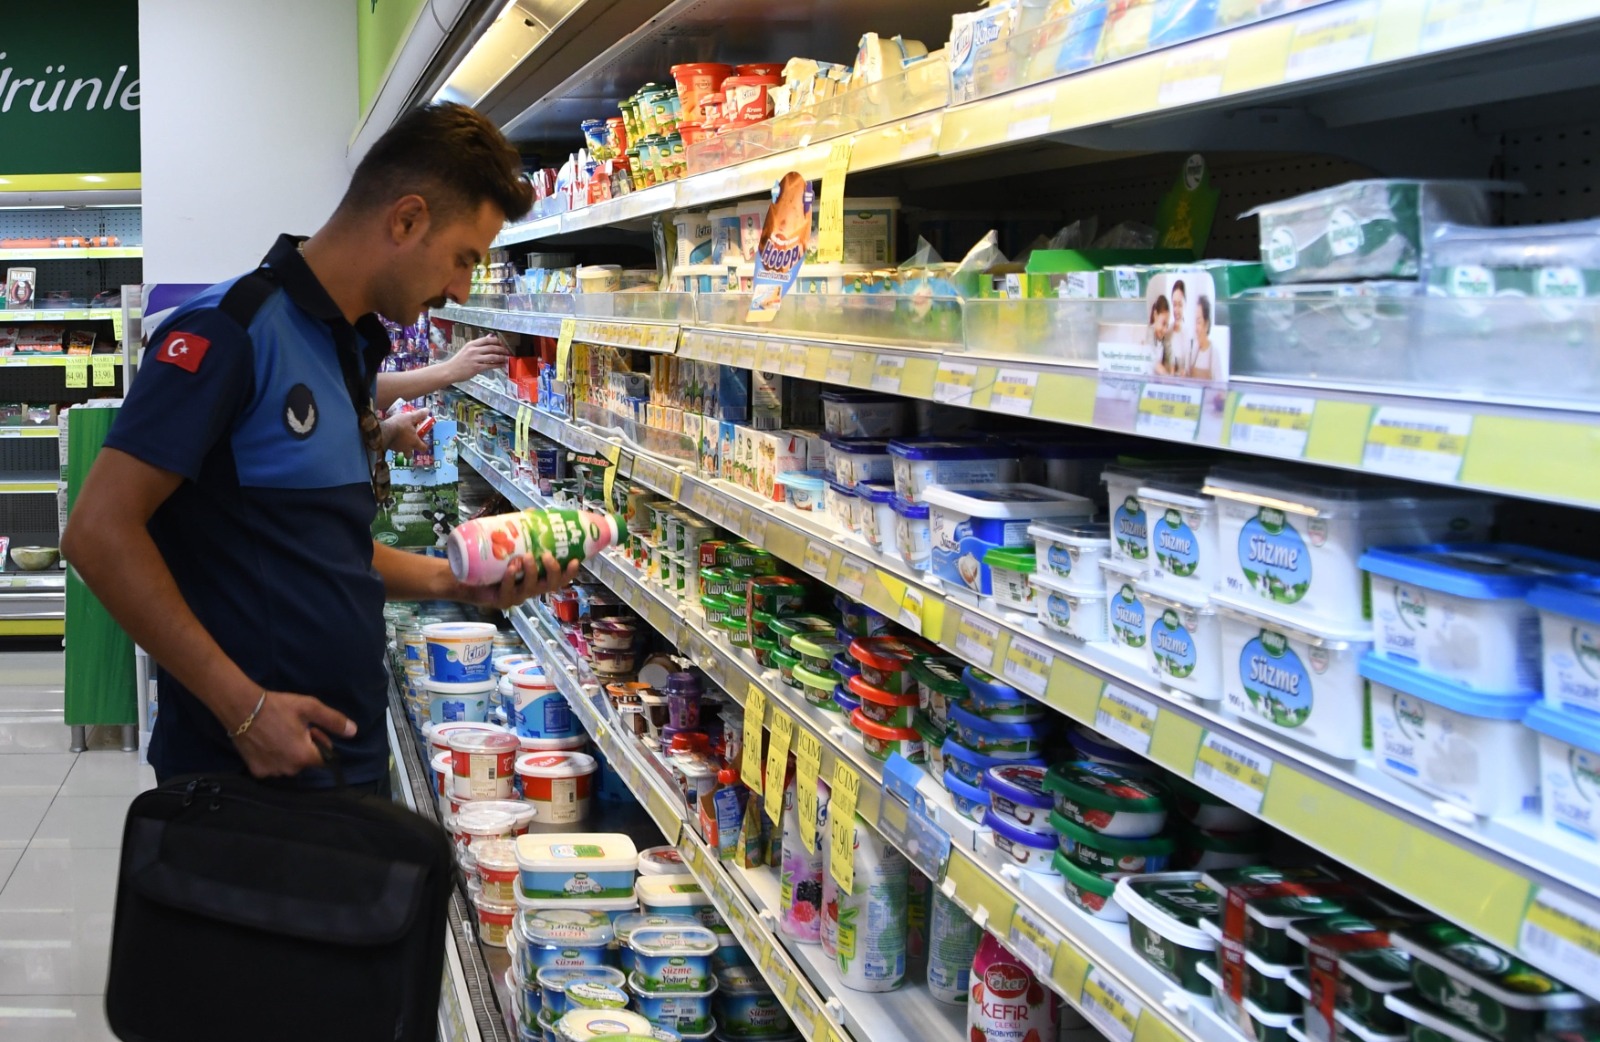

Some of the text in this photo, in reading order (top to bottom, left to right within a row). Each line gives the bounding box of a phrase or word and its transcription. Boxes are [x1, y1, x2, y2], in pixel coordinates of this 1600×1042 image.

[1160, 531, 1191, 556] Süzme
[1249, 535, 1298, 572] Süzme
[1116, 604, 1142, 628] Süzme
[1158, 631, 1188, 658] Süzme
[1250, 655, 1299, 696] Süzme
[661, 966, 692, 975] Süzme
[662, 975, 689, 985] Yoğurt
